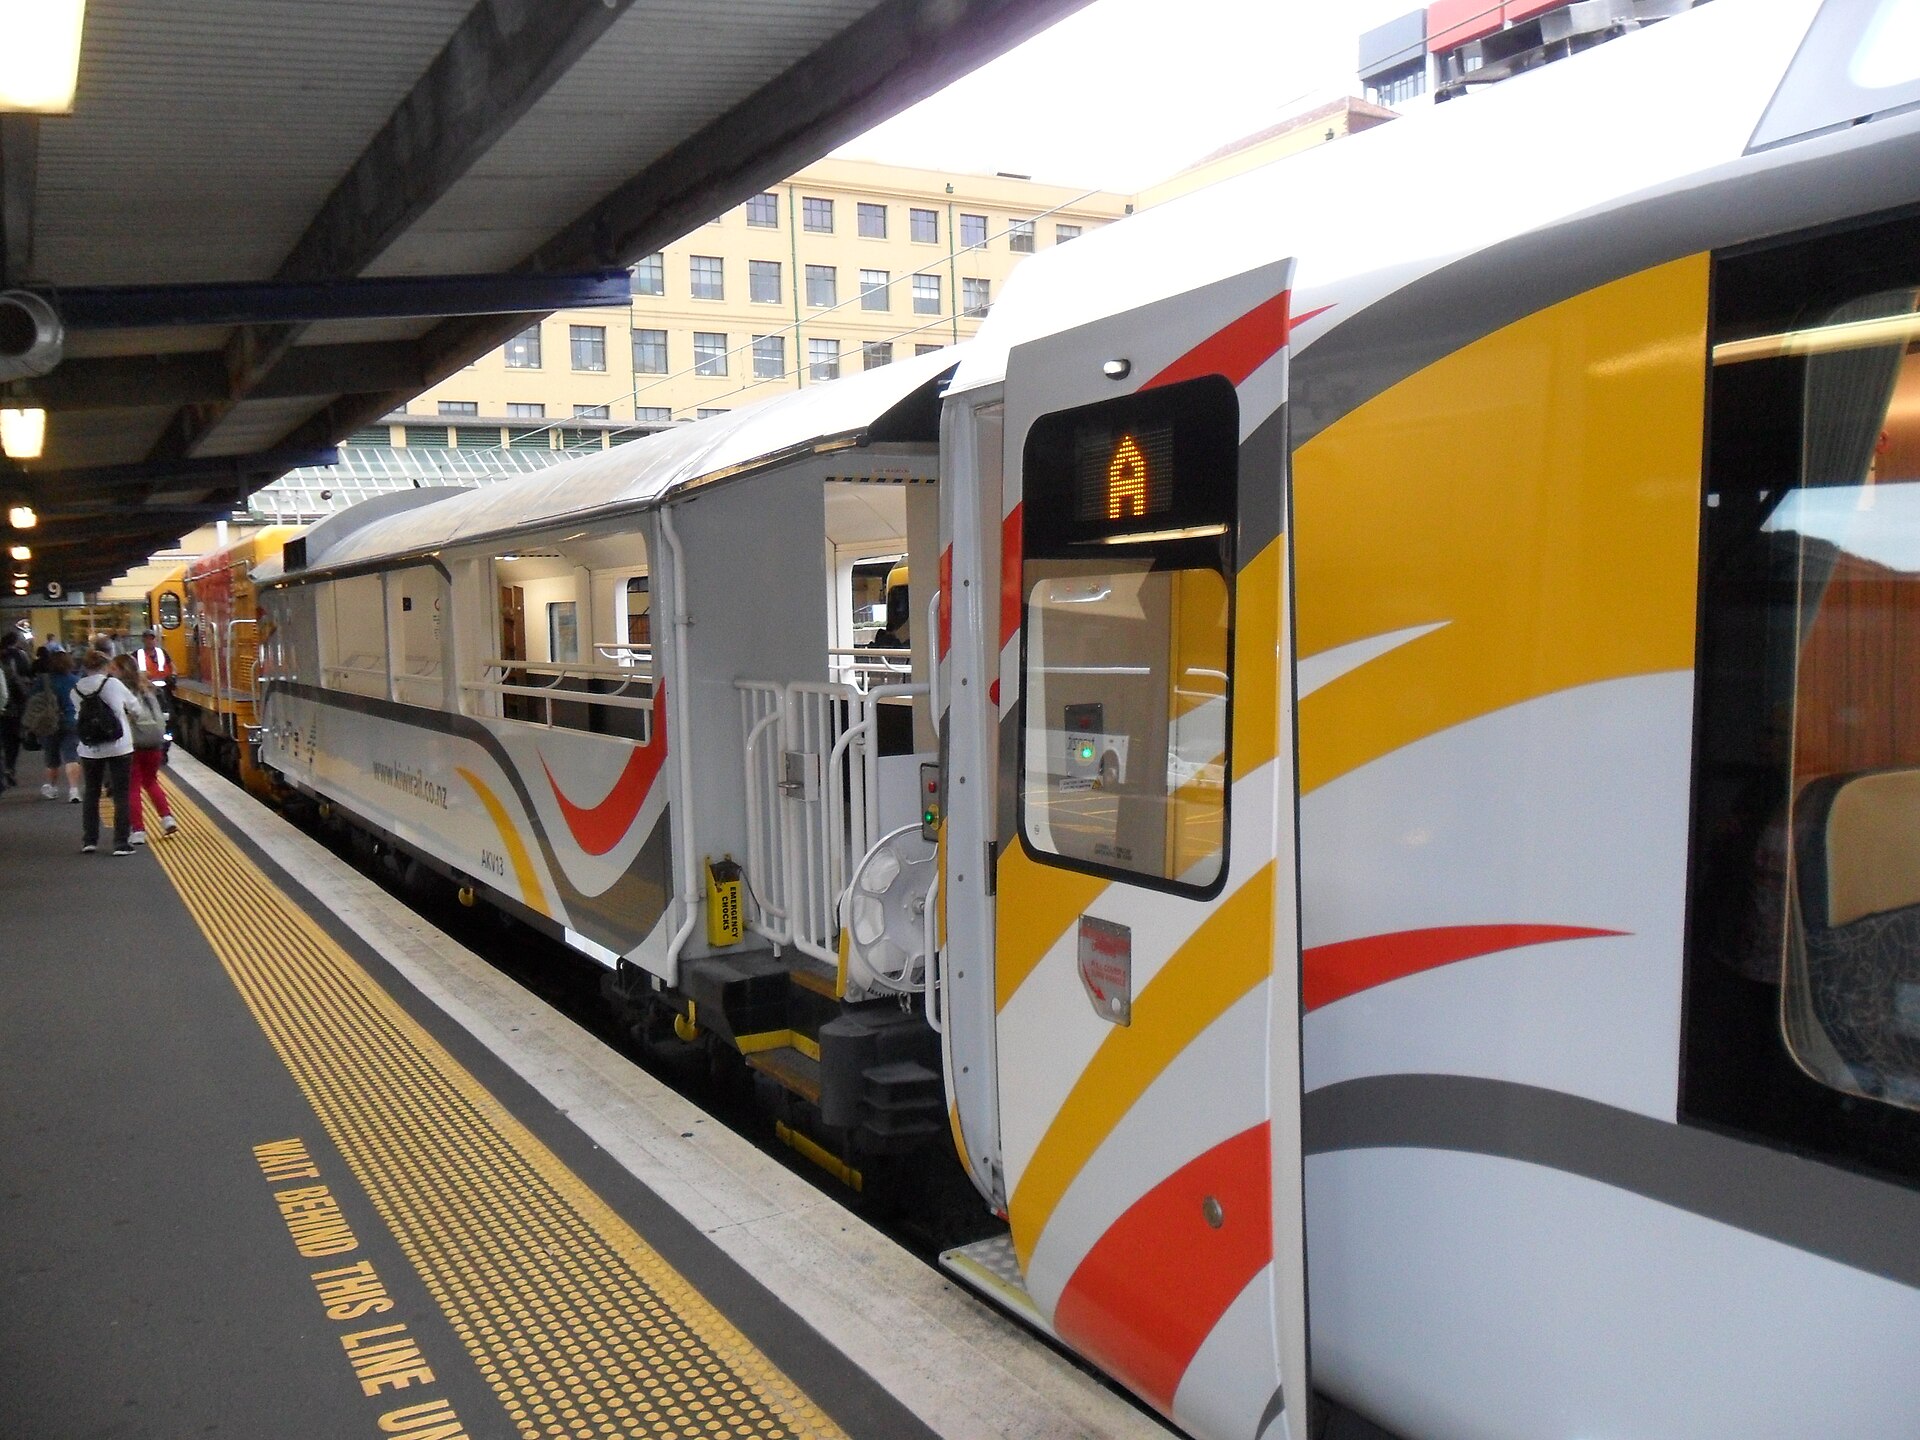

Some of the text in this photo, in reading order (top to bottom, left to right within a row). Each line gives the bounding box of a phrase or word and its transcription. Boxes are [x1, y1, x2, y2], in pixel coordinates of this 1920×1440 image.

[1109, 434, 1145, 520] A
[47, 581, 62, 598] 9
[373, 760, 448, 810] www.kiwirail.co.nz
[721, 896, 730, 931] CHOCKS
[729, 886, 739, 938] EMERGENCY
[252, 1137, 321, 1182] WAIT
[273, 1185, 359, 1257] BEHIND
[310, 1260, 394, 1320] THIS
[339, 1323, 436, 1397] LINE
